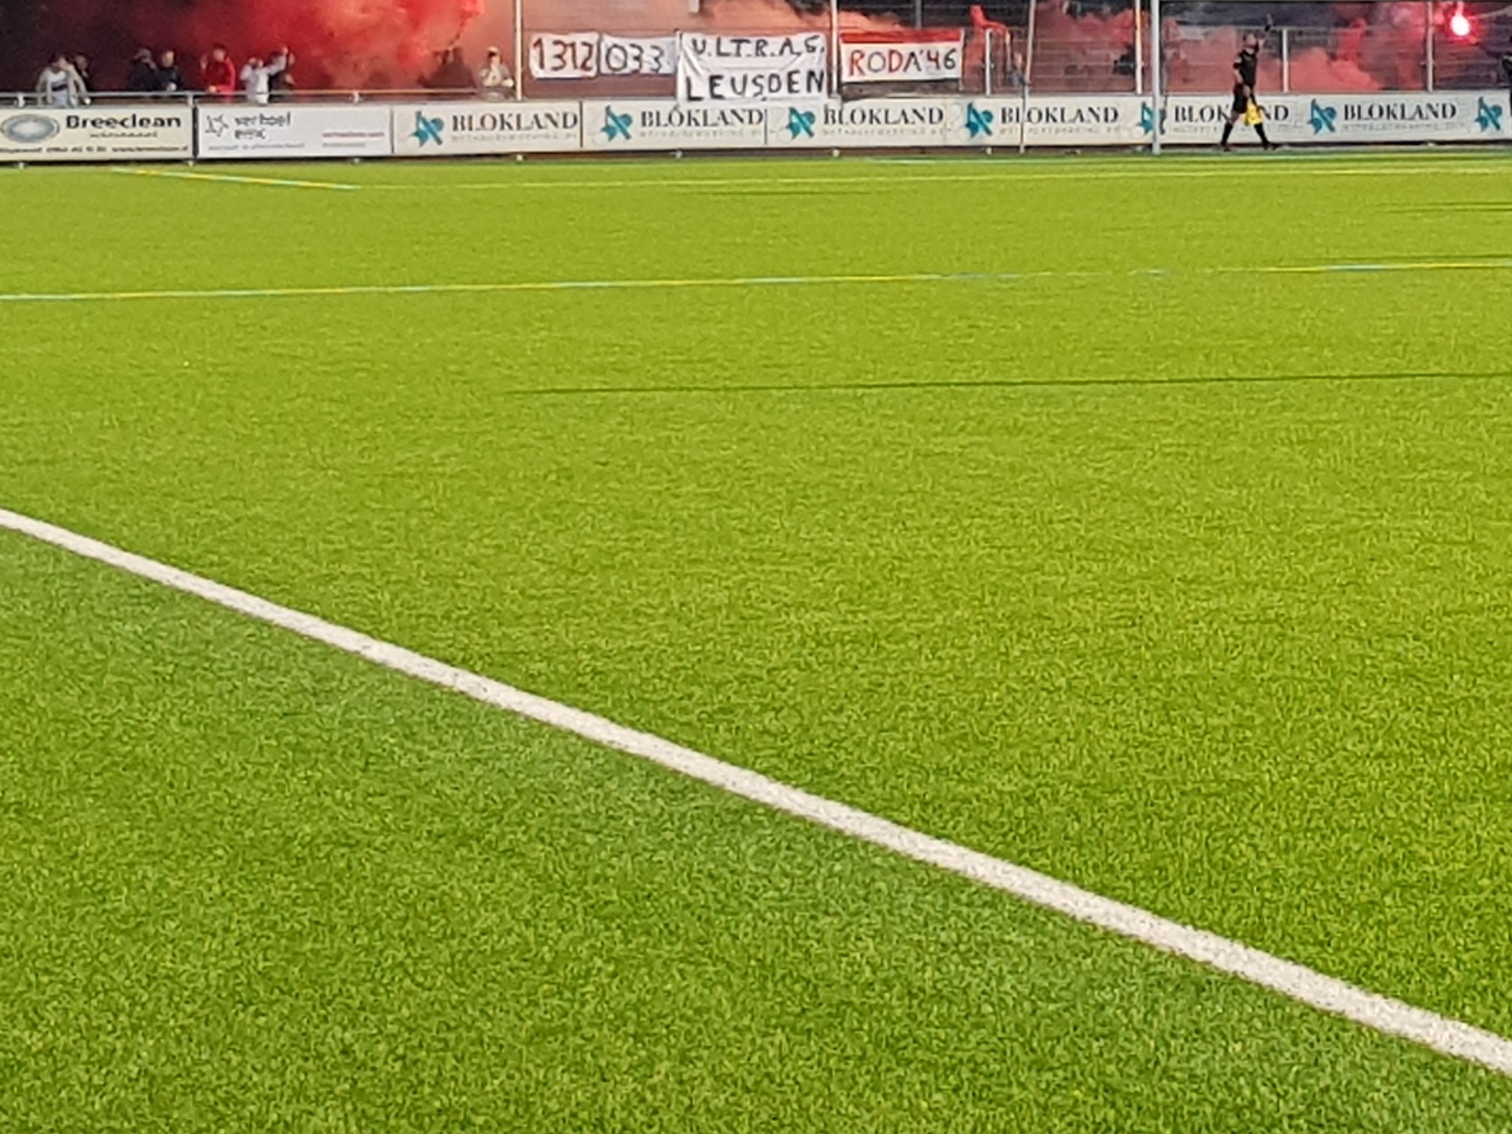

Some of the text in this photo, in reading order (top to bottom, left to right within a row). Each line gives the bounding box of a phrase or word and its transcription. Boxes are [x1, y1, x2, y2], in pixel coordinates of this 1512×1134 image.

[532, 37, 594, 71] 1312
[605, 43, 664, 74] 033
[685, 69, 825, 102] LEUSDEN
[66, 114, 182, 129] Breeclean
[452, 109, 578, 132] BLOKLAND
[640, 107, 764, 128] BLOKLAND
[823, 106, 944, 125] BLOKLAND
[1343, 102, 1457, 122] BLOKLAND
